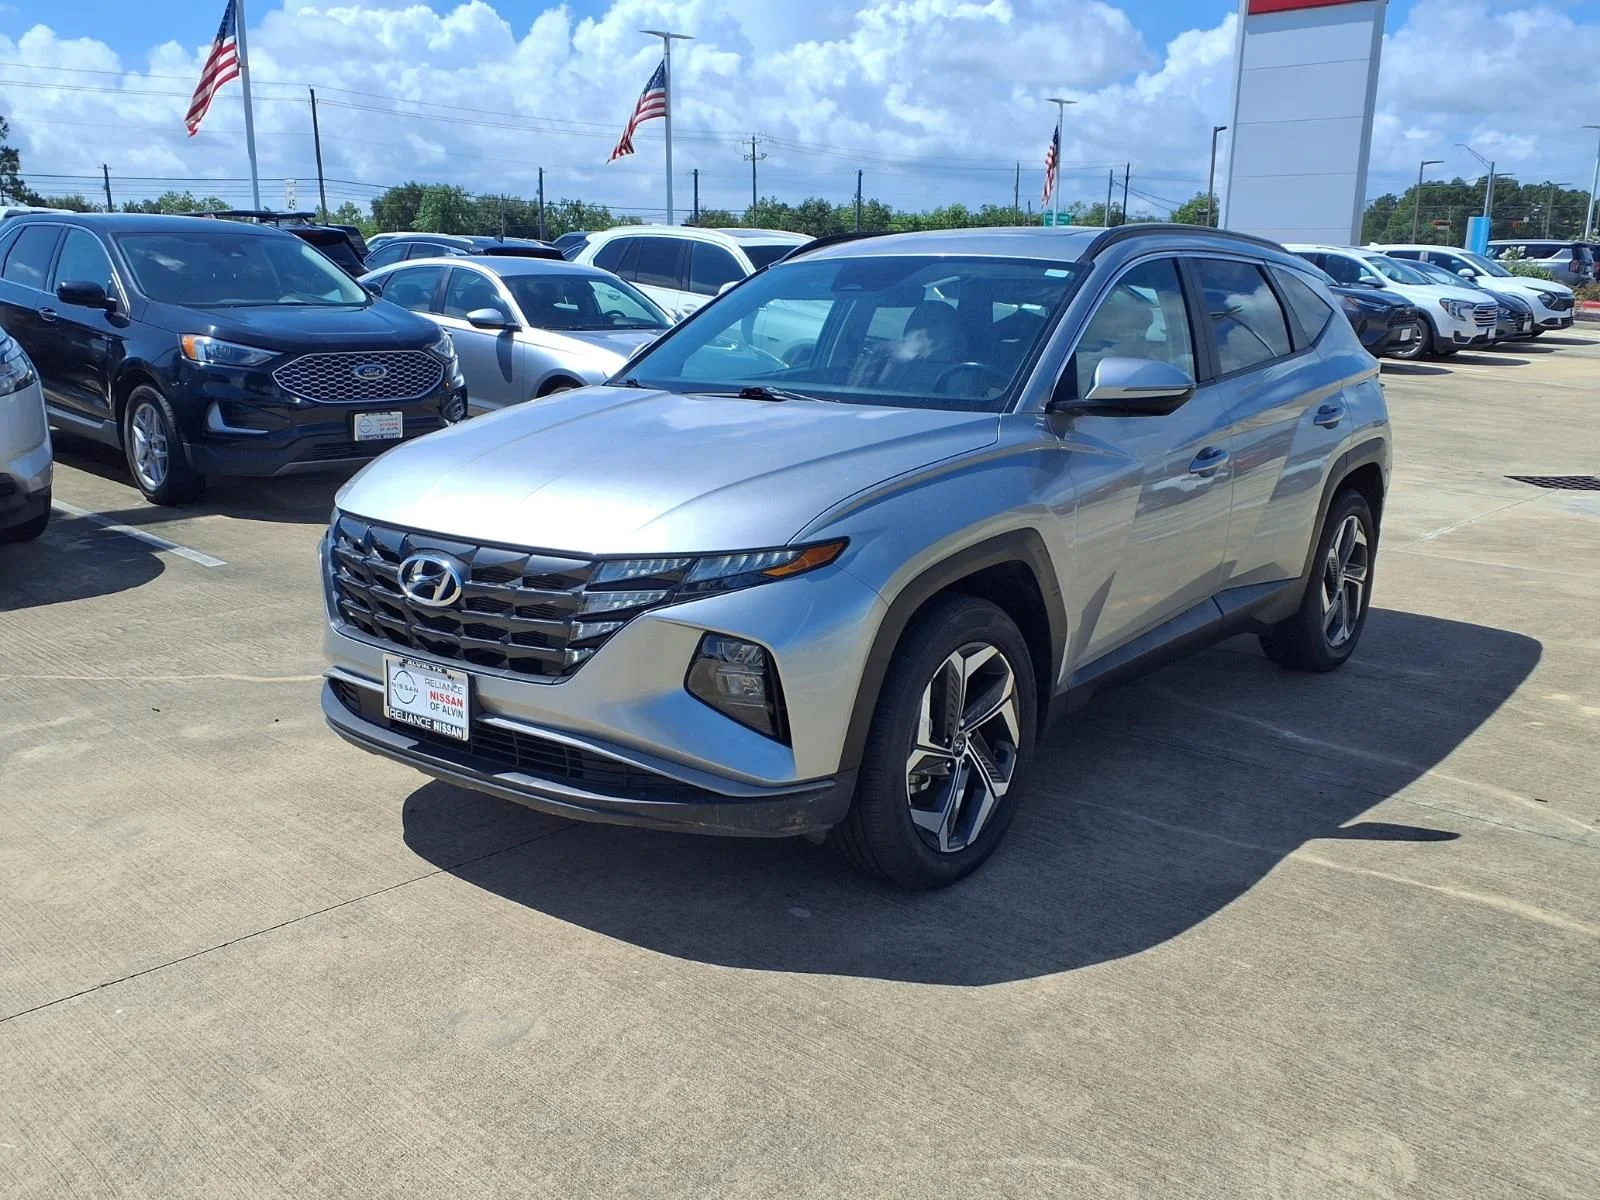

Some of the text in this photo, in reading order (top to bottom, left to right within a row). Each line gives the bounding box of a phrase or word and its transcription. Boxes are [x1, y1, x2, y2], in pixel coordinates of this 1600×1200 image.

[288, 199, 296, 211] 45
[391, 681, 419, 694] NISSAN
[424, 677, 463, 695] RELIANCE
[430, 691, 463, 708] NISSAN
[430, 702, 464, 719] OF ALVIN
[389, 708, 462, 738] RELIANCE NISSAN
